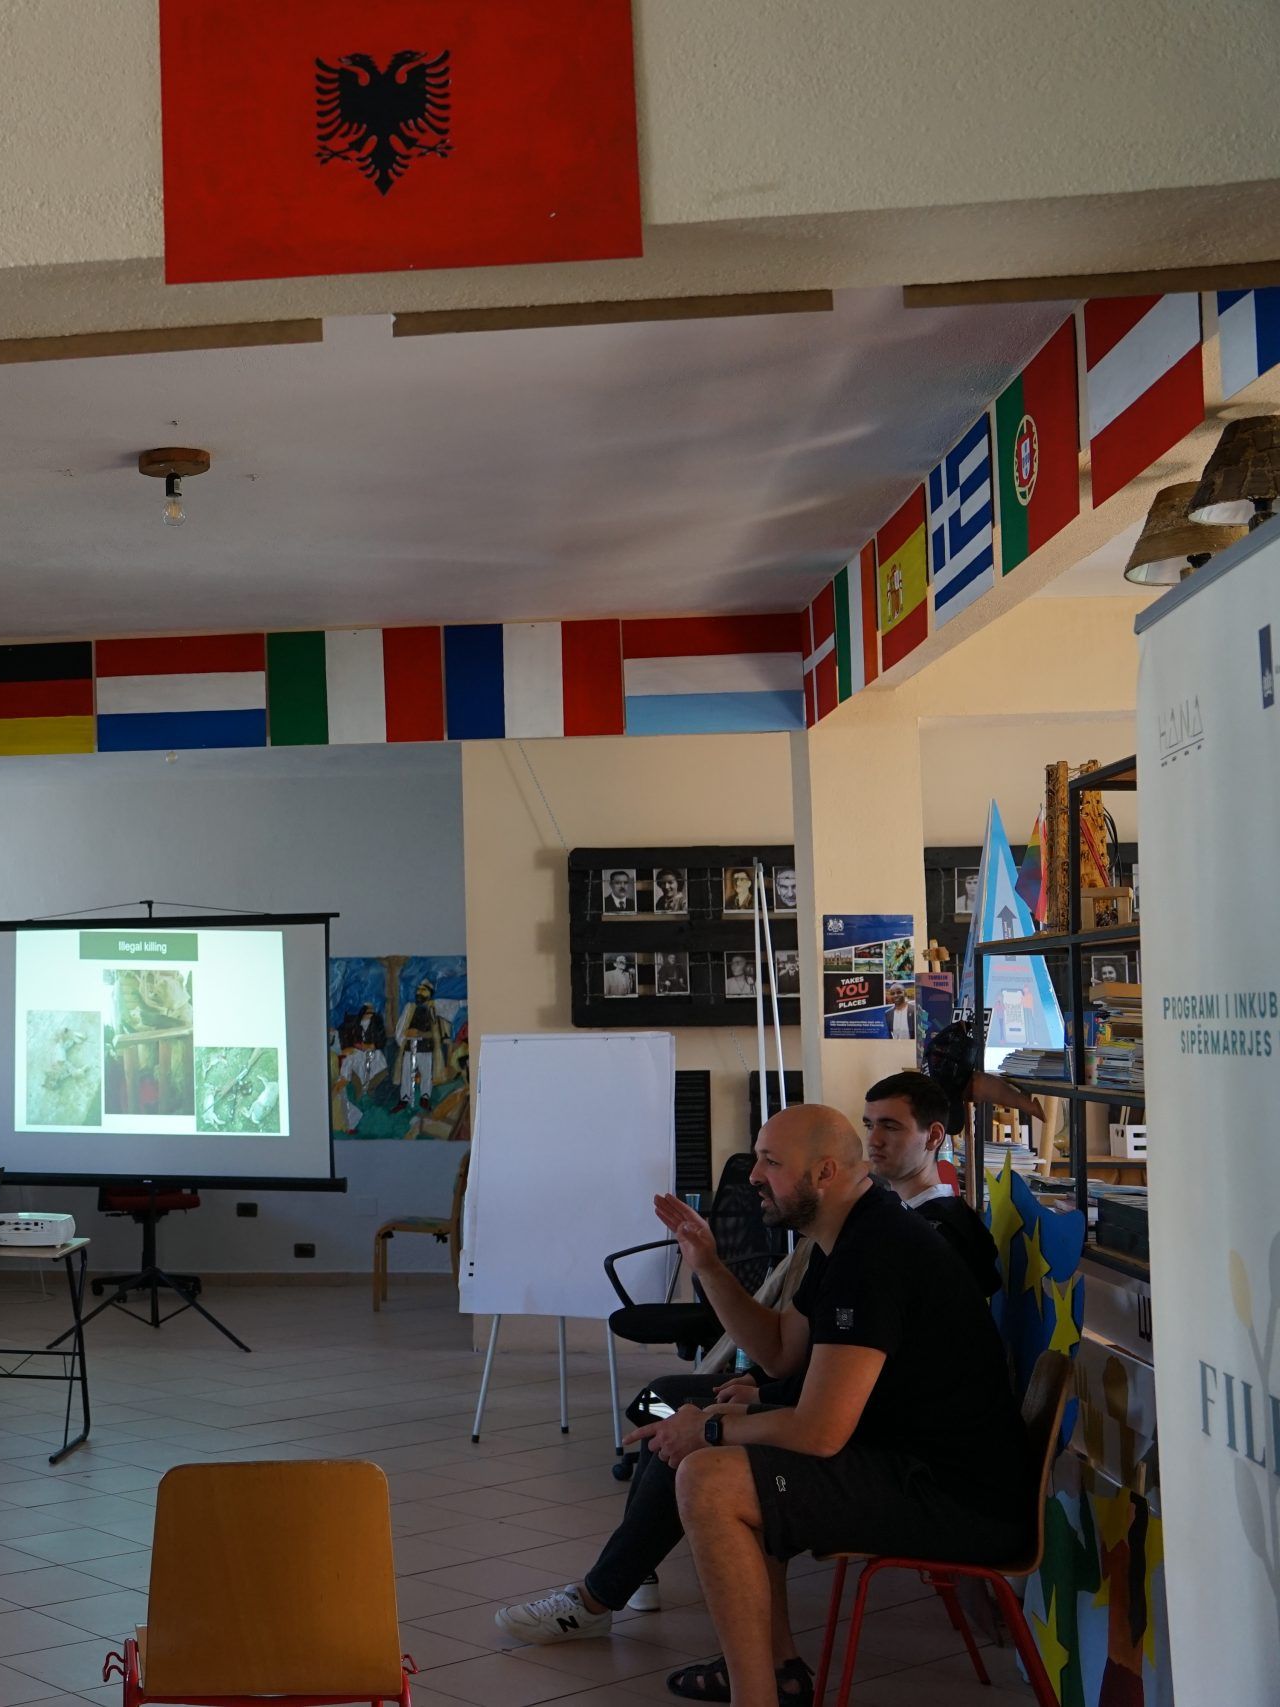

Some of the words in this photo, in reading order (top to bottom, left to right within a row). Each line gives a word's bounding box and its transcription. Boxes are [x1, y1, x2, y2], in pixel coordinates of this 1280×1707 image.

[1158, 694, 1204, 753] HANA
[118, 940, 142, 954] Illegal
[144, 941, 167, 955] killing
[836, 982, 869, 998] YOU
[841, 976, 865, 985] TAKES
[838, 998, 867, 1009] PLACES
[1163, 994, 1220, 1020] PROGRAMI
[1180, 1023, 1272, 1057] SIPËRMARRJES
[1198, 1360, 1280, 1478] FIL
